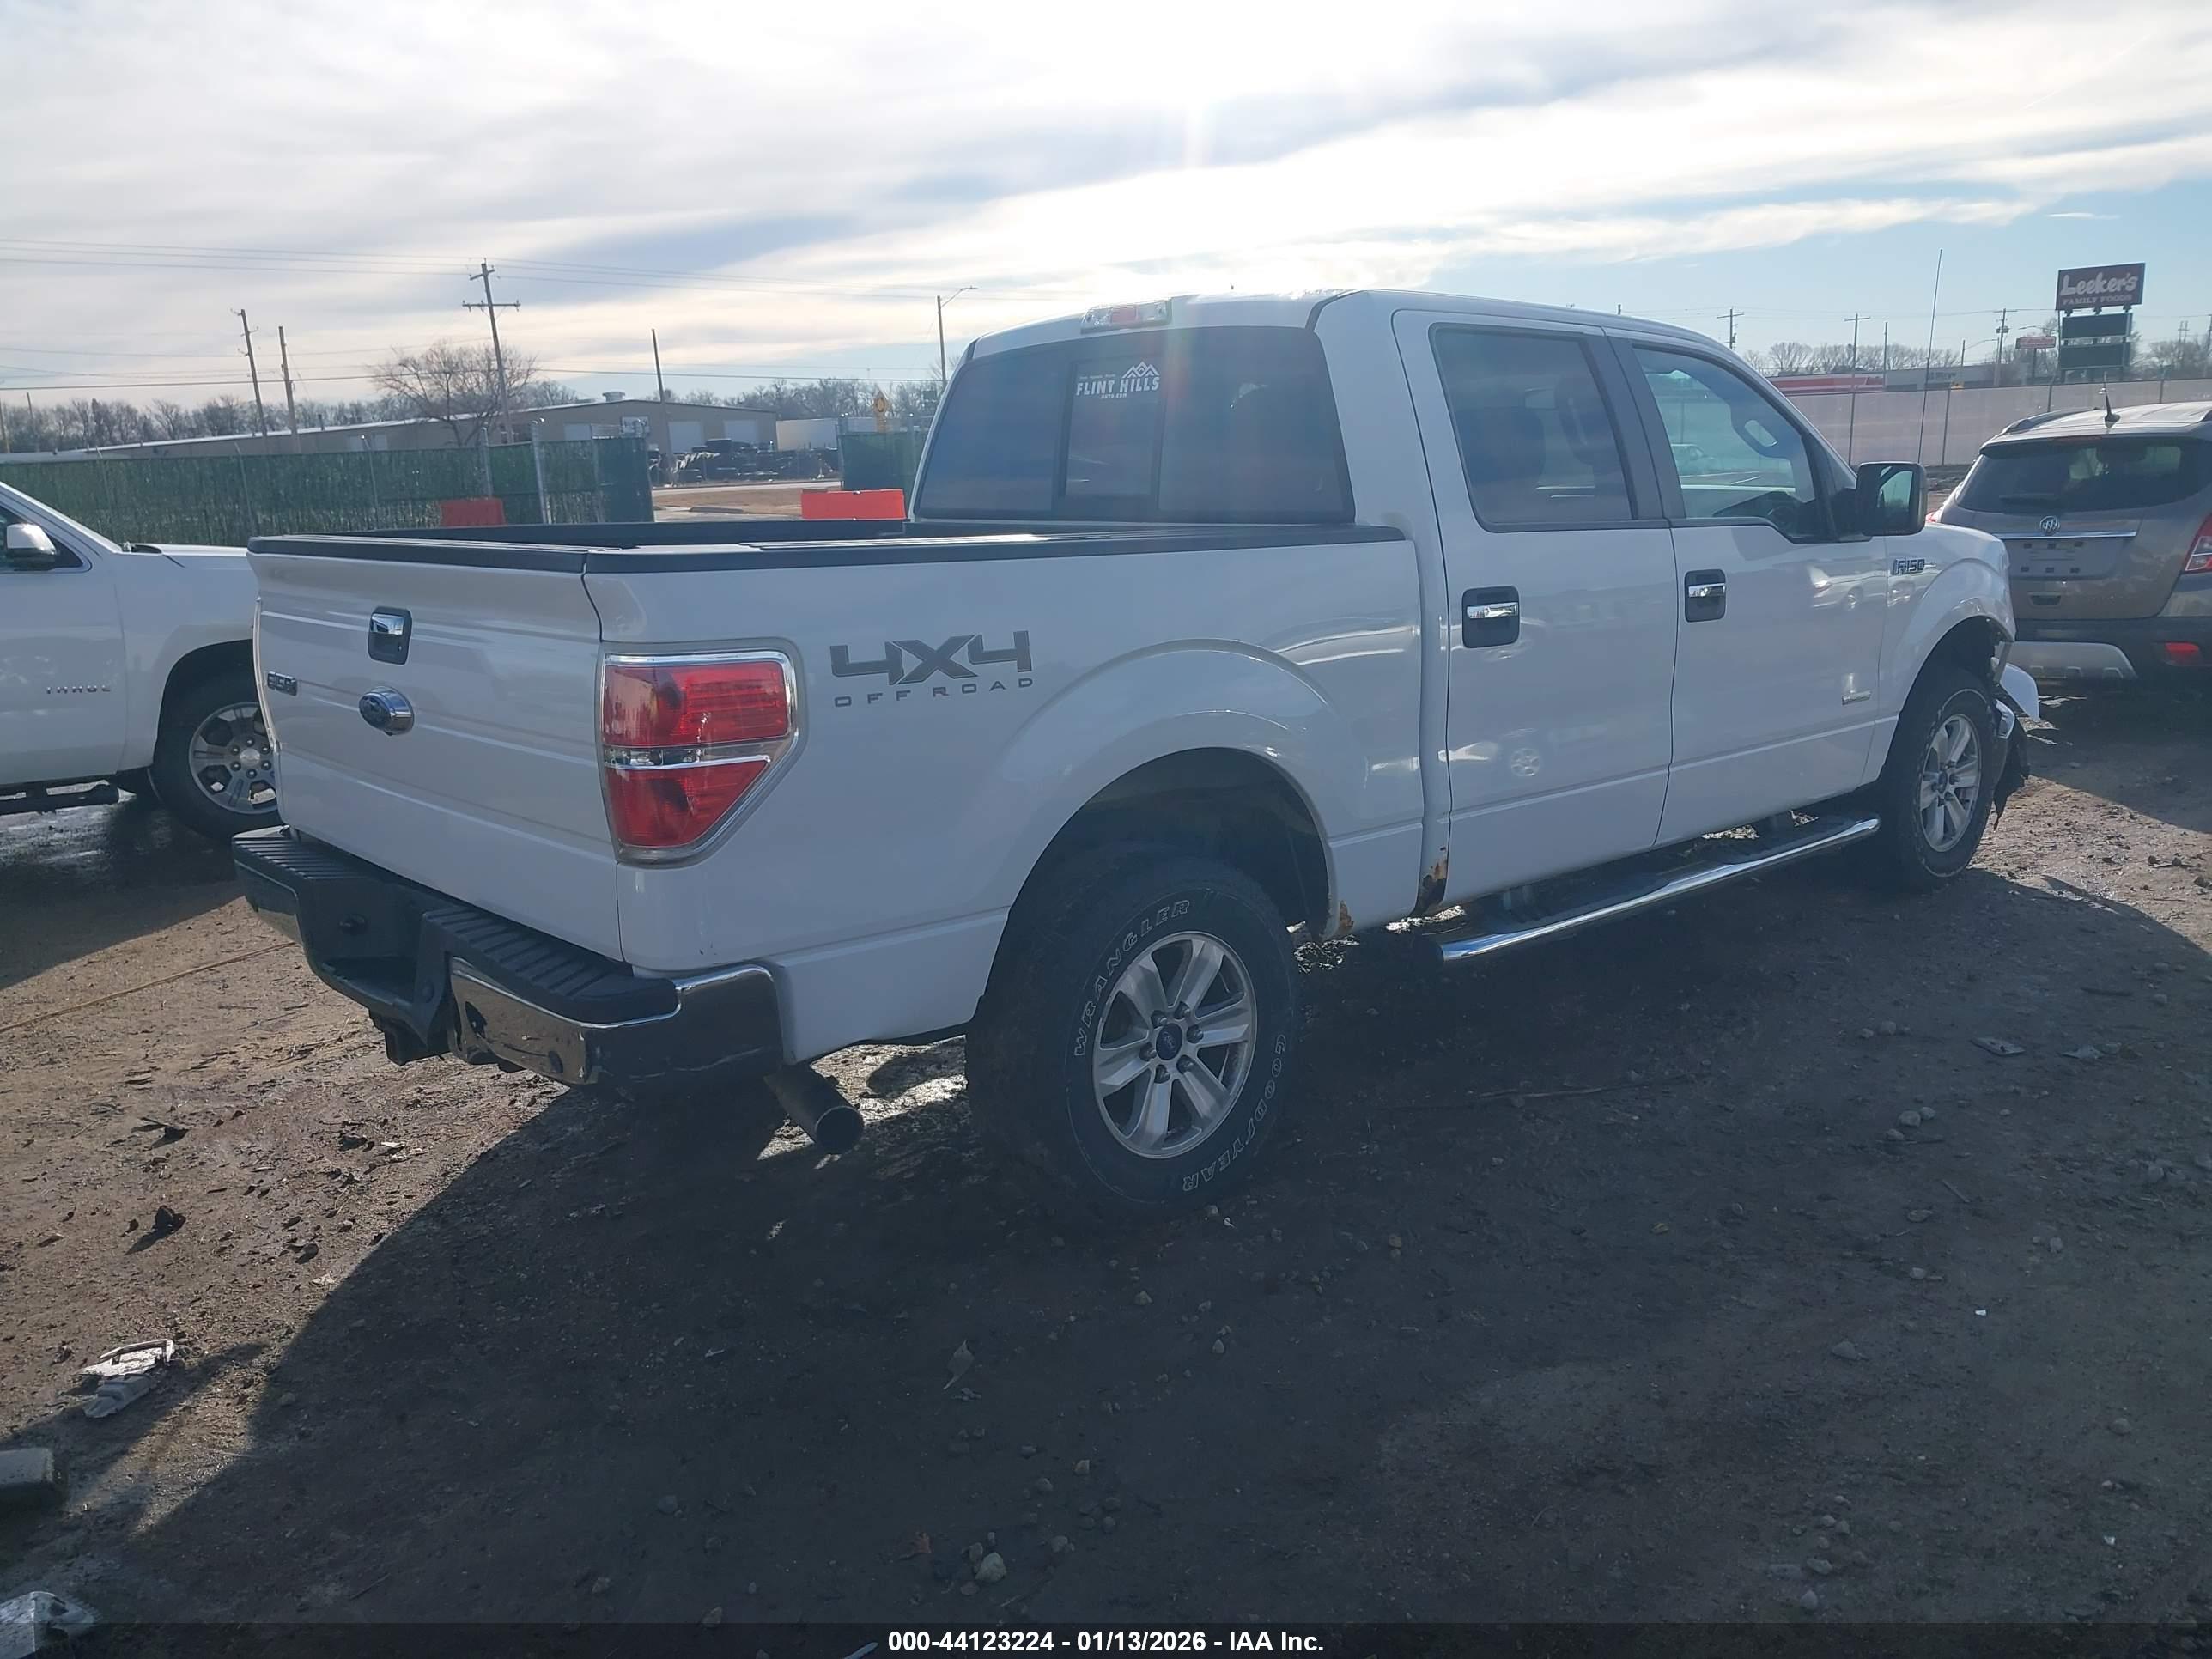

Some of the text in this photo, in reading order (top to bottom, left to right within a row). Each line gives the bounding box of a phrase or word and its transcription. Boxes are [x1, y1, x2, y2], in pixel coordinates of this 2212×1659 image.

[2060, 272, 2139, 296] Leeker's
[2063, 296, 2098, 306] FAMILY
[1076, 380, 1115, 396] FLINT
[1119, 376, 1161, 392] HILLS
[830, 630, 1033, 686] 4X4
[834, 678, 1034, 708] OFF ROAD
[1074, 899, 1190, 1056] WRANGLER
[1182, 1034, 1286, 1192] GOODYEAR
